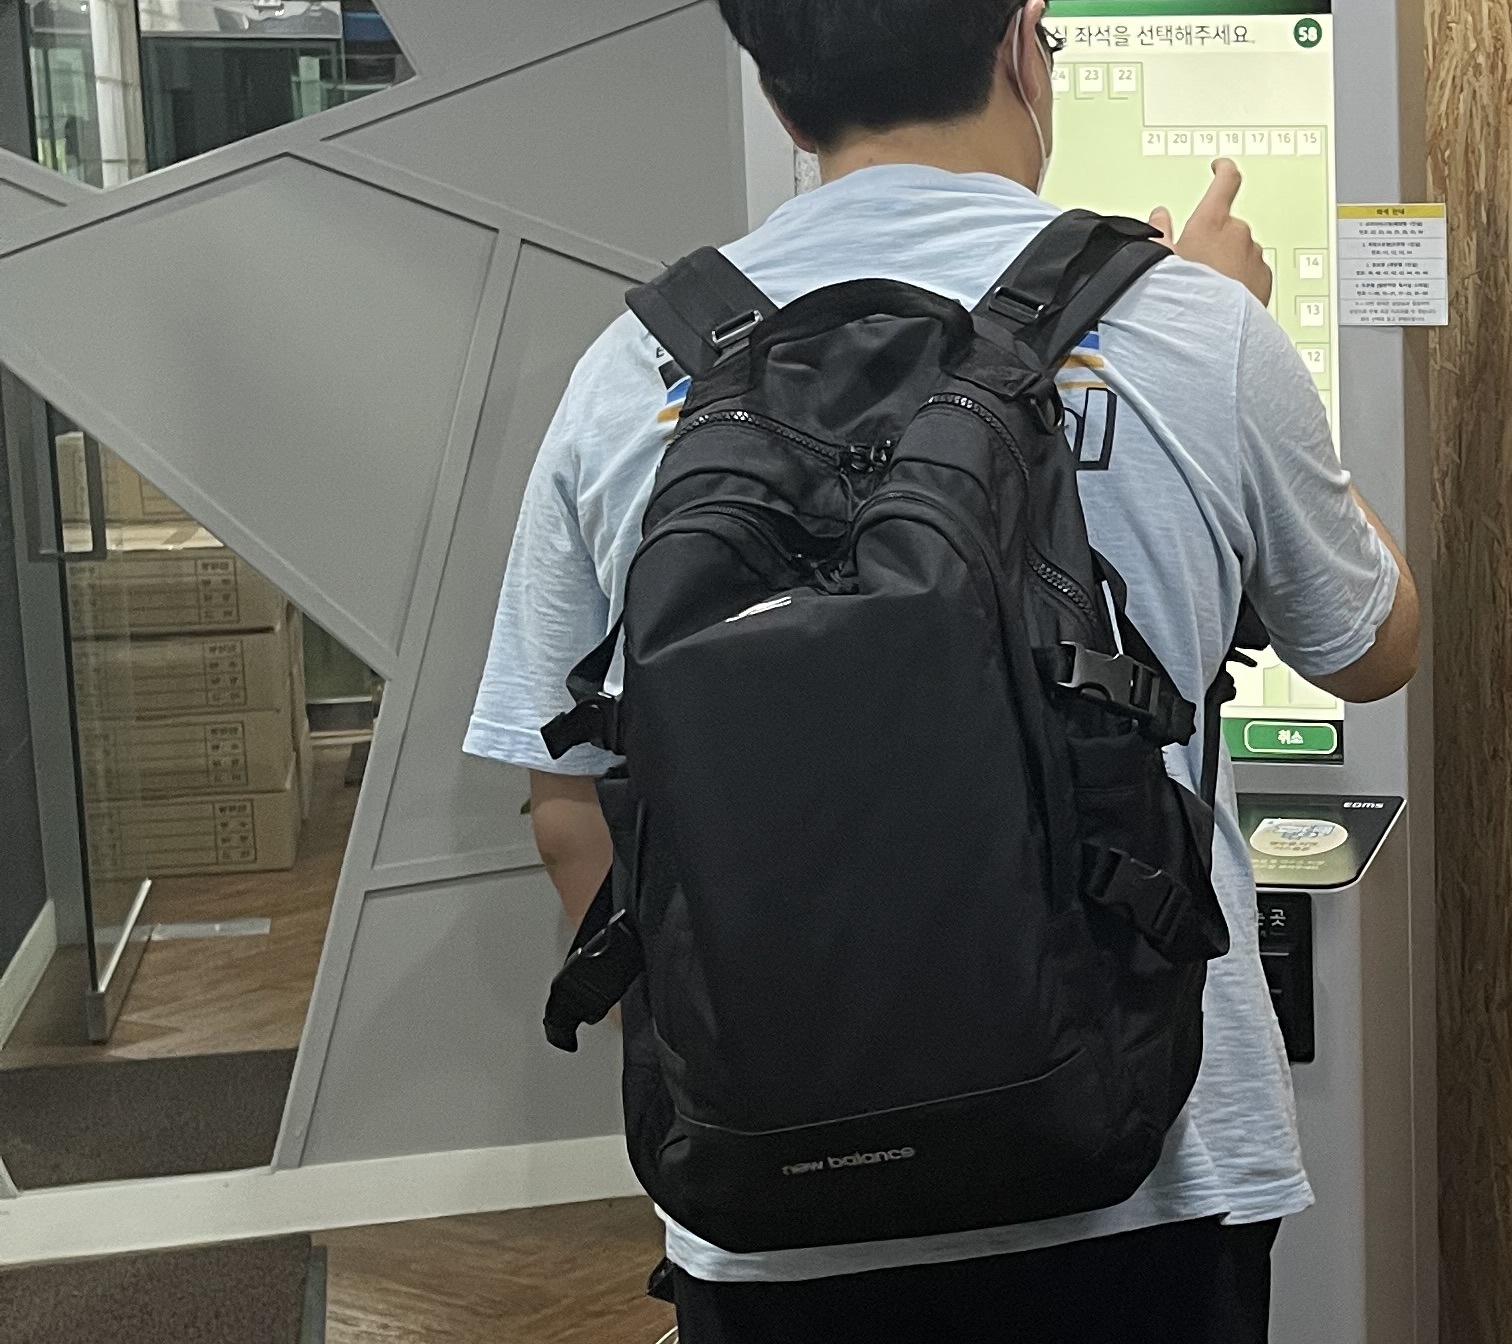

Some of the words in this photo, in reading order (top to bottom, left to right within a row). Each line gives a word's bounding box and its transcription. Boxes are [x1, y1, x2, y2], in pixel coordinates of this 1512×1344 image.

[1075, 25, 1131, 47] 좌석을
[1137, 25, 1256, 47] 선택해주세요.
[1298, 26, 1318, 42] 58
[1085, 69, 1099, 81] 23
[1118, 69, 1133, 81] 22
[1147, 133, 1161, 144] 21
[1172, 133, 1188, 144] 20
[1200, 133, 1213, 144] 19
[1225, 133, 1239, 144] 18
[1251, 133, 1265, 144] 17
[1277, 133, 1291, 144] 16
[1303, 133, 1317, 144] 15
[1306, 256, 1319, 267] 14
[1307, 304, 1320, 315] 13
[1307, 351, 1321, 362] 12
[1277, 729, 1304, 744] 취소
[1269, 909, 1286, 927] 곳
[782, 1160, 824, 1176] new
[827, 1146, 917, 1169] balance
